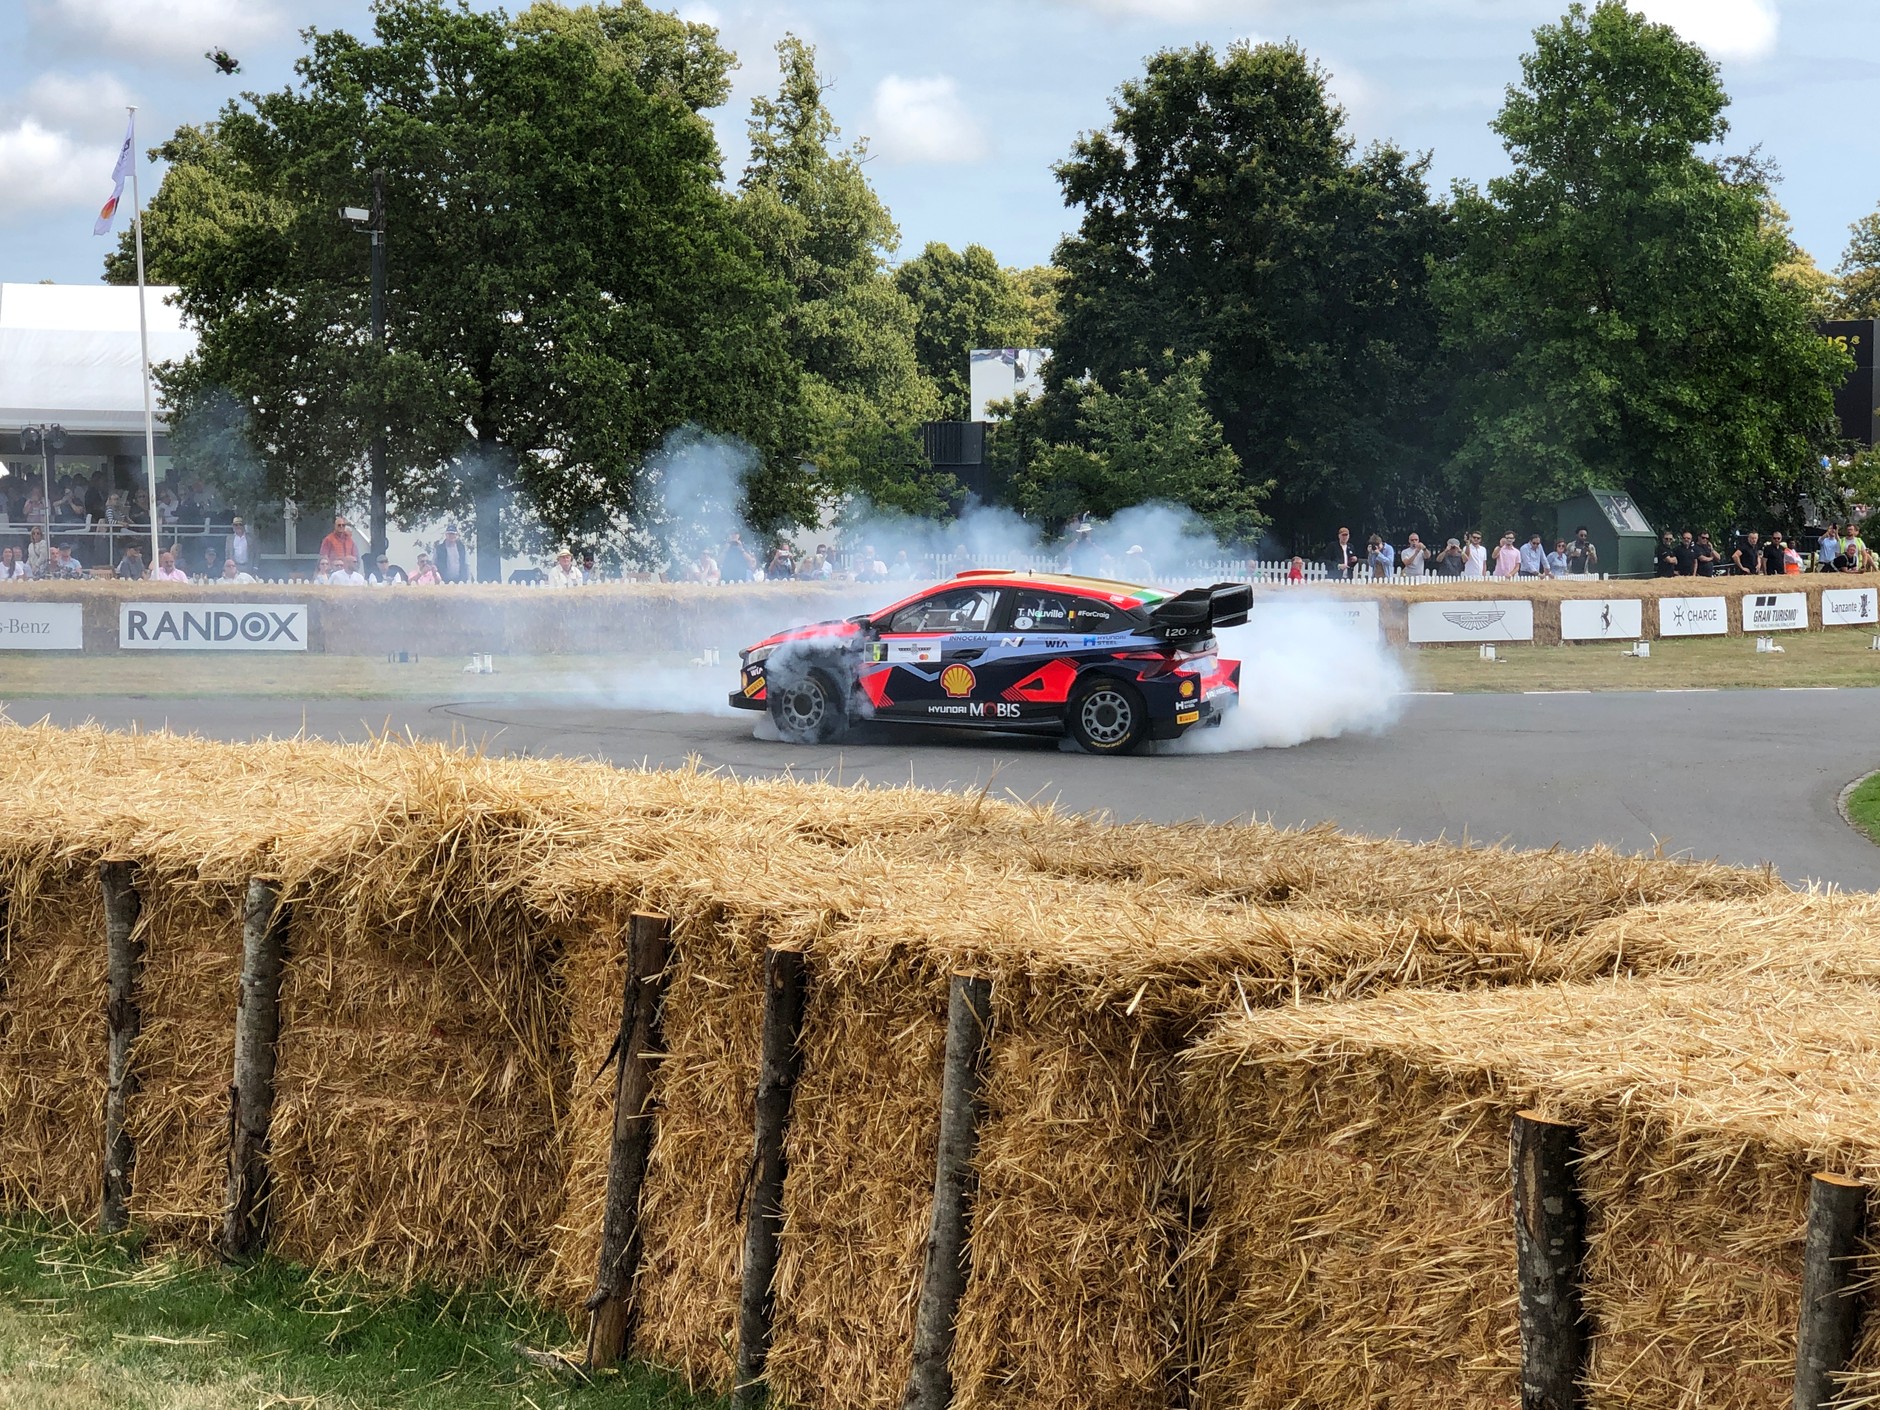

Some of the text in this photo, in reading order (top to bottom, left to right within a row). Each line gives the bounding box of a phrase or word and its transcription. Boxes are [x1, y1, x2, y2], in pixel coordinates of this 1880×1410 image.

[1018, 608, 1064, 618] T. Neuville
[1831, 602, 1858, 613] Lanzante
[1077, 610, 1110, 619] #ForCraig
[1687, 610, 1717, 621] CHARGE
[1753, 609, 1796, 622] GRAN TURISMO
[127, 611, 299, 642] RANDOX
[970, 702, 1020, 717] MOBIS
